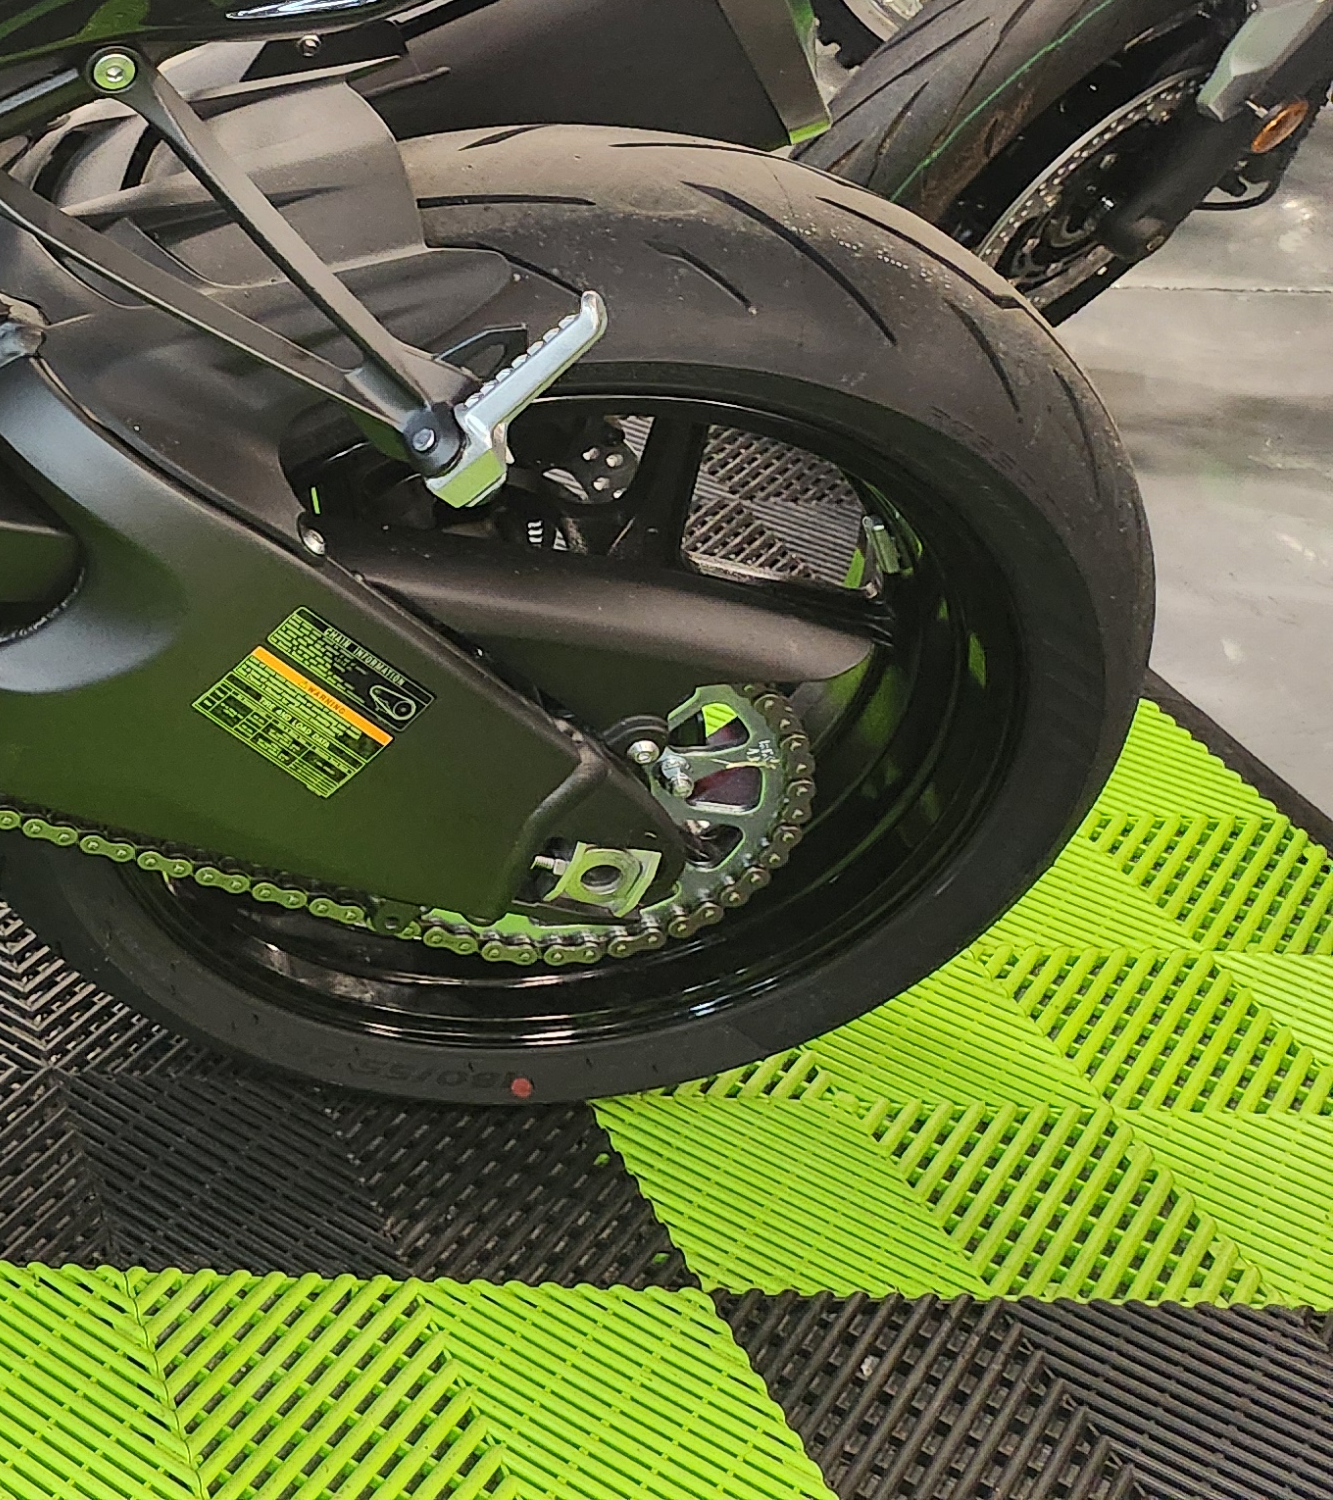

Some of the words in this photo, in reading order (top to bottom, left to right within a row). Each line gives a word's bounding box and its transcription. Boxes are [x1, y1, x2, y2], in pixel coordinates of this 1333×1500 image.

[322, 627, 351, 649] CHAIN
[351, 644, 406, 687] INFORMATION
[259, 696, 276, 713] TIRE
[275, 707, 293, 723] AND
[291, 718, 312, 736] LOAD
[311, 732, 331, 749] DATA
[307, 685, 347, 716] WARNING
